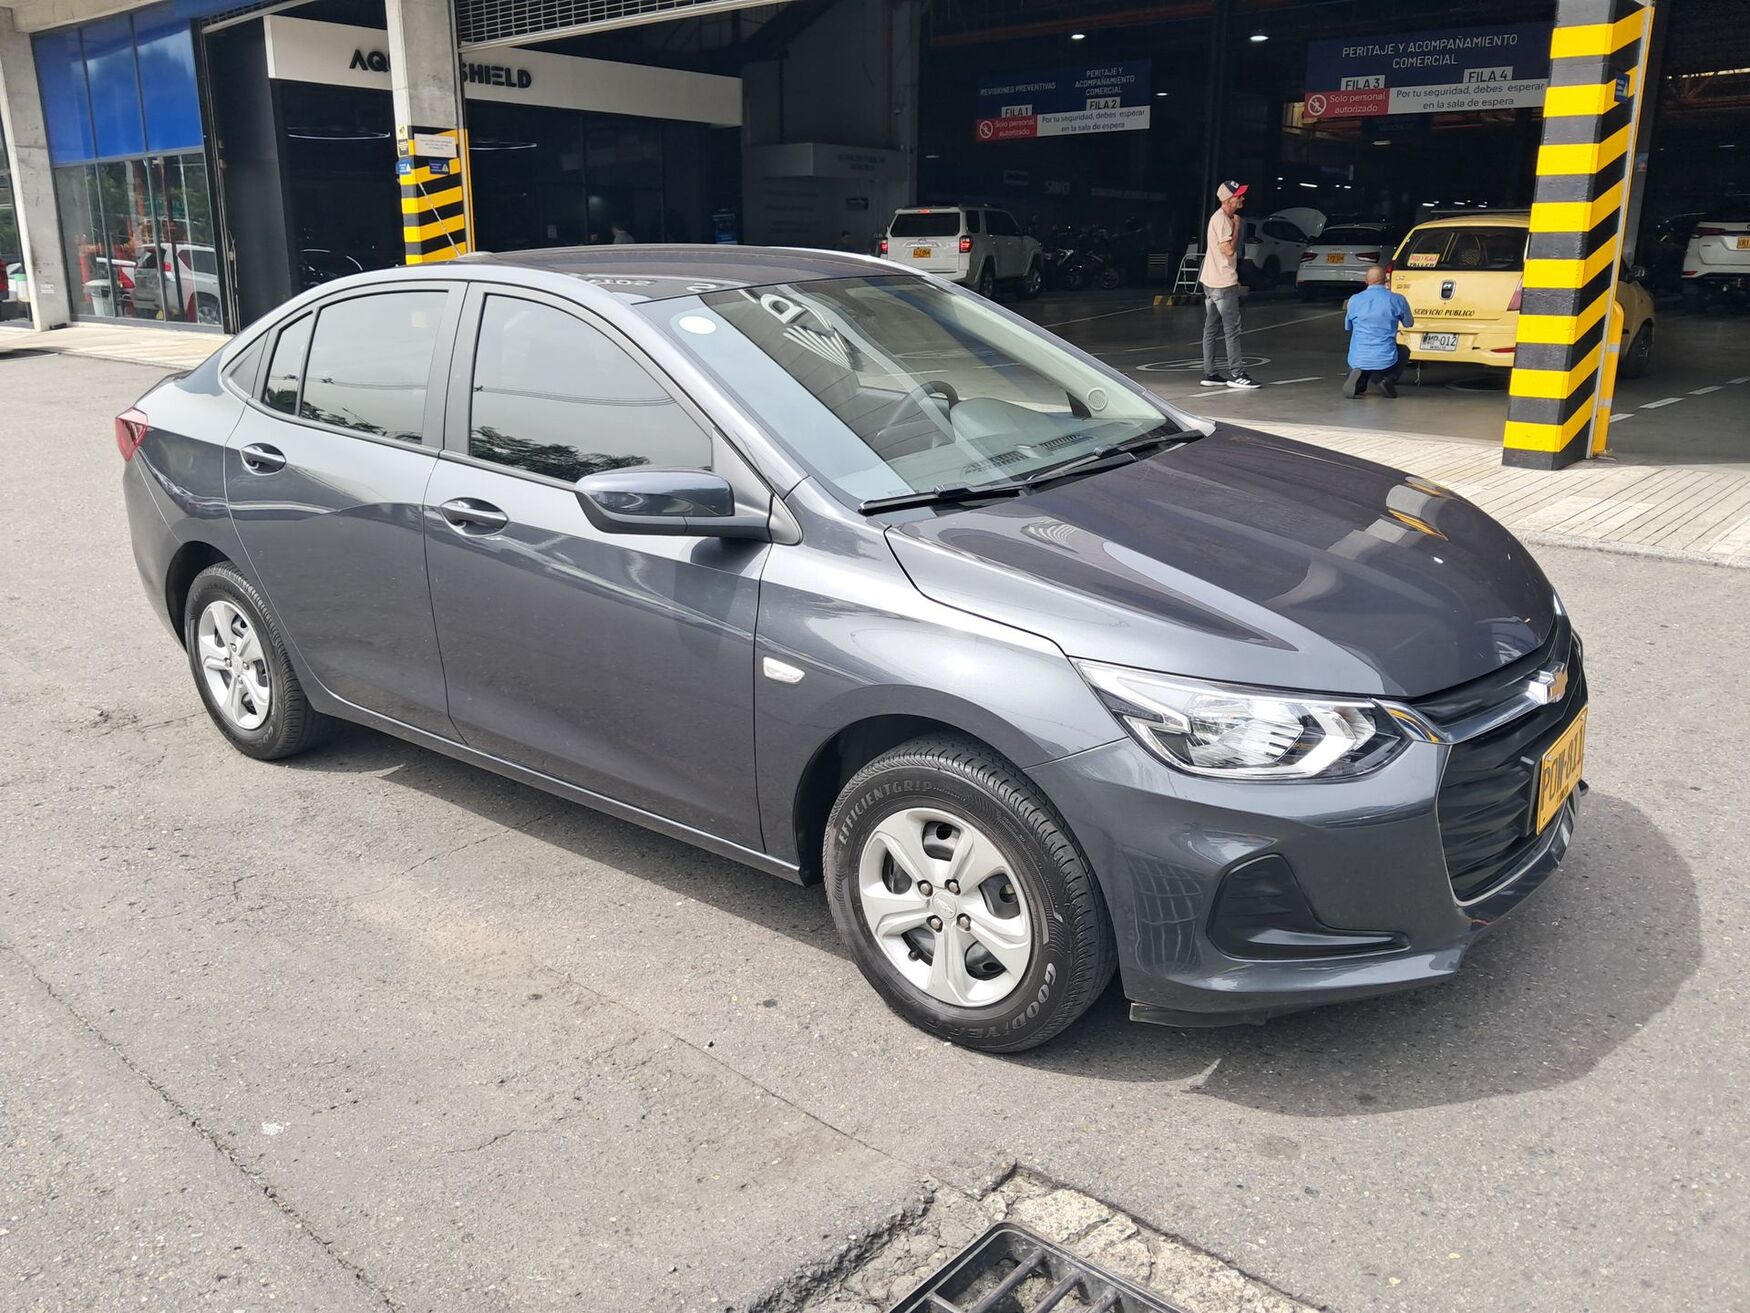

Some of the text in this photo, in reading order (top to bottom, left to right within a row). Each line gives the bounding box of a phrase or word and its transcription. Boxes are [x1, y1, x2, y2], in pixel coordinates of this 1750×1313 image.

[1342, 34, 1518, 57] PERITAJE Y ACOMPAÑAMIENTO
[349, 49, 391, 73] AQ
[1392, 55, 1459, 69] COMERCIAL
[461, 62, 532, 89] SHIELD
[1086, 68, 1117, 78] PERITAJE
[1469, 69, 1508, 83] FILA 4
[1345, 77, 1381, 91] FILA 3
[1086, 86, 1122, 96] COMERCIAL
[1396, 83, 1545, 98] Por tu seguridad, debes esperar
[1329, 92, 1385, 103] Solo personal
[1423, 97, 1514, 110] en la sala de espera
[1089, 99, 1118, 111] FILA 2
[1334, 103, 1378, 114] autorizado
[1005, 107, 1024, 117] FILA
[1096, 111, 1116, 120] debes
[1119, 110, 1145, 120] esperar
[1078, 123, 1091, 131] sala
[1092, 122, 1101, 130] de
[1101, 122, 1125, 132] espera
[1413, 308, 1443, 316] SERVICIO
[838, 780, 933, 845] EFFICIENTGRIP
